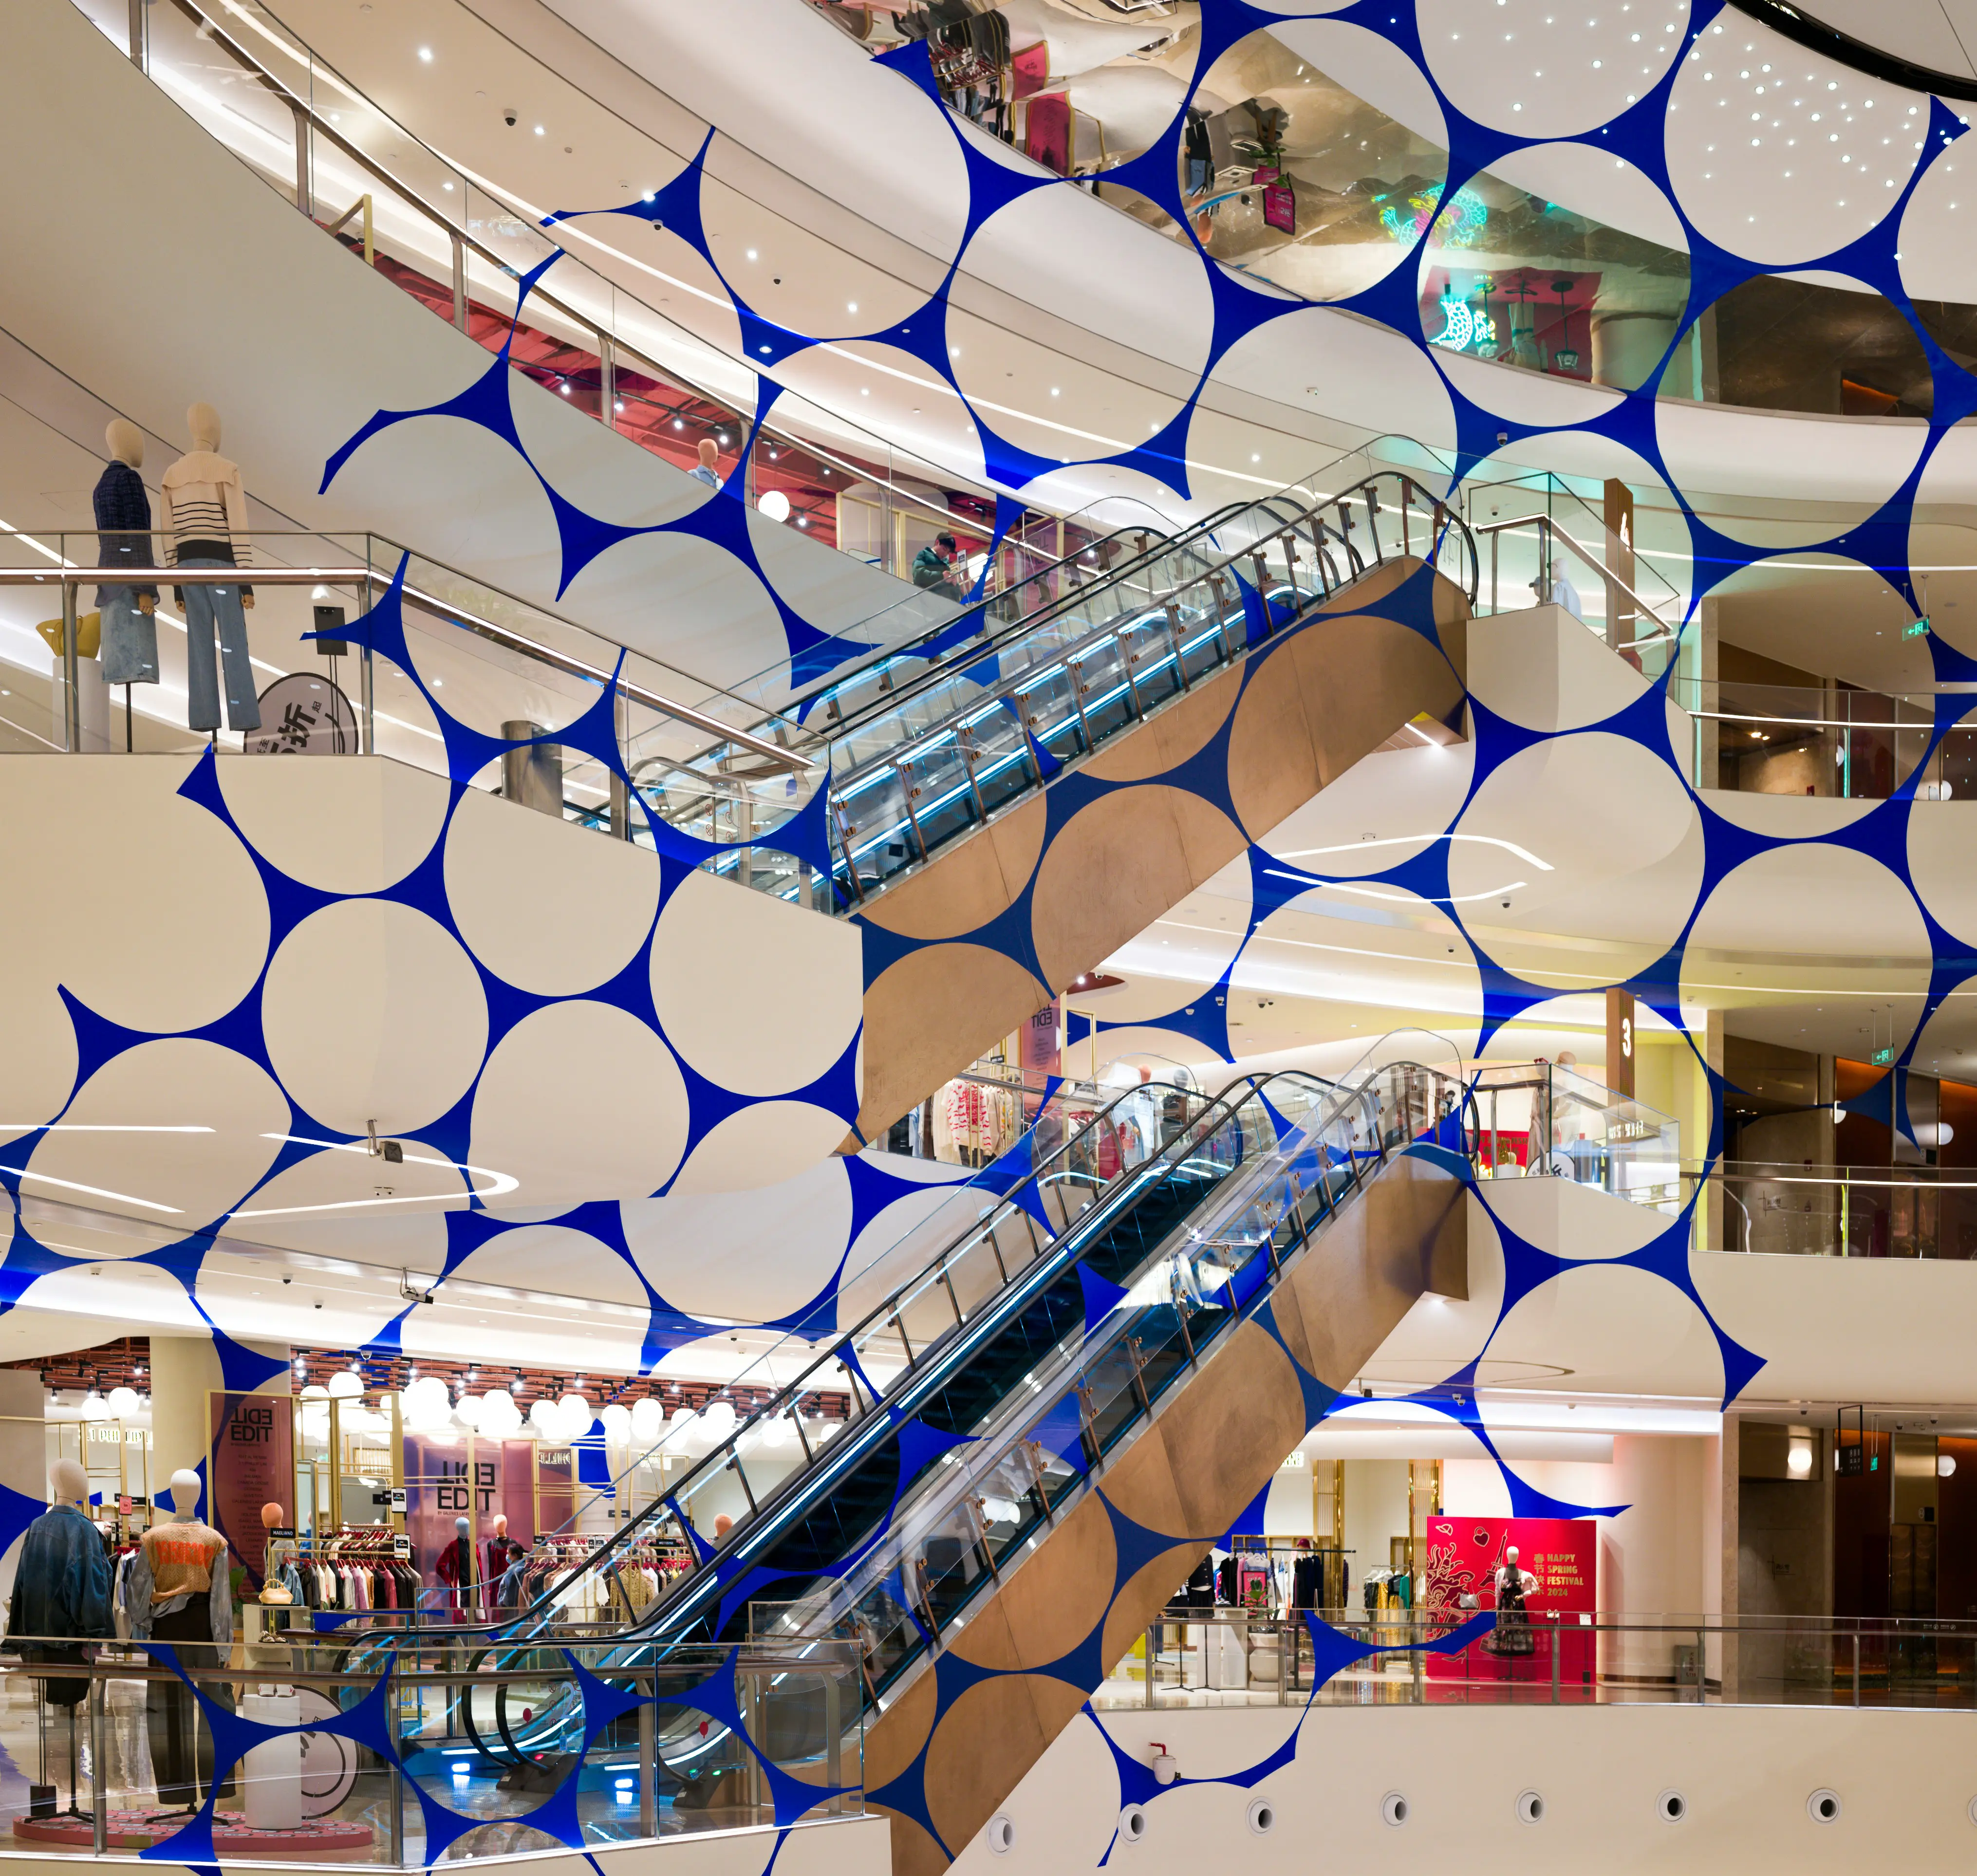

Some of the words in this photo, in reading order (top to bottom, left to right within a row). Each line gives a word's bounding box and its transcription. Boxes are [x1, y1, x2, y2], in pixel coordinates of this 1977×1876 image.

[1623, 1018, 1631, 1057] 3
[230, 1408, 272, 1425] EDIT
[231, 1425, 273, 1442] EDIT
[1547, 1553, 1576, 1562] HAPPY
[1547, 1565, 1578, 1574] SPRING
[1547, 1576, 1584, 1585] FESTIVAL
[1547, 1588, 1568, 1596] 2024
